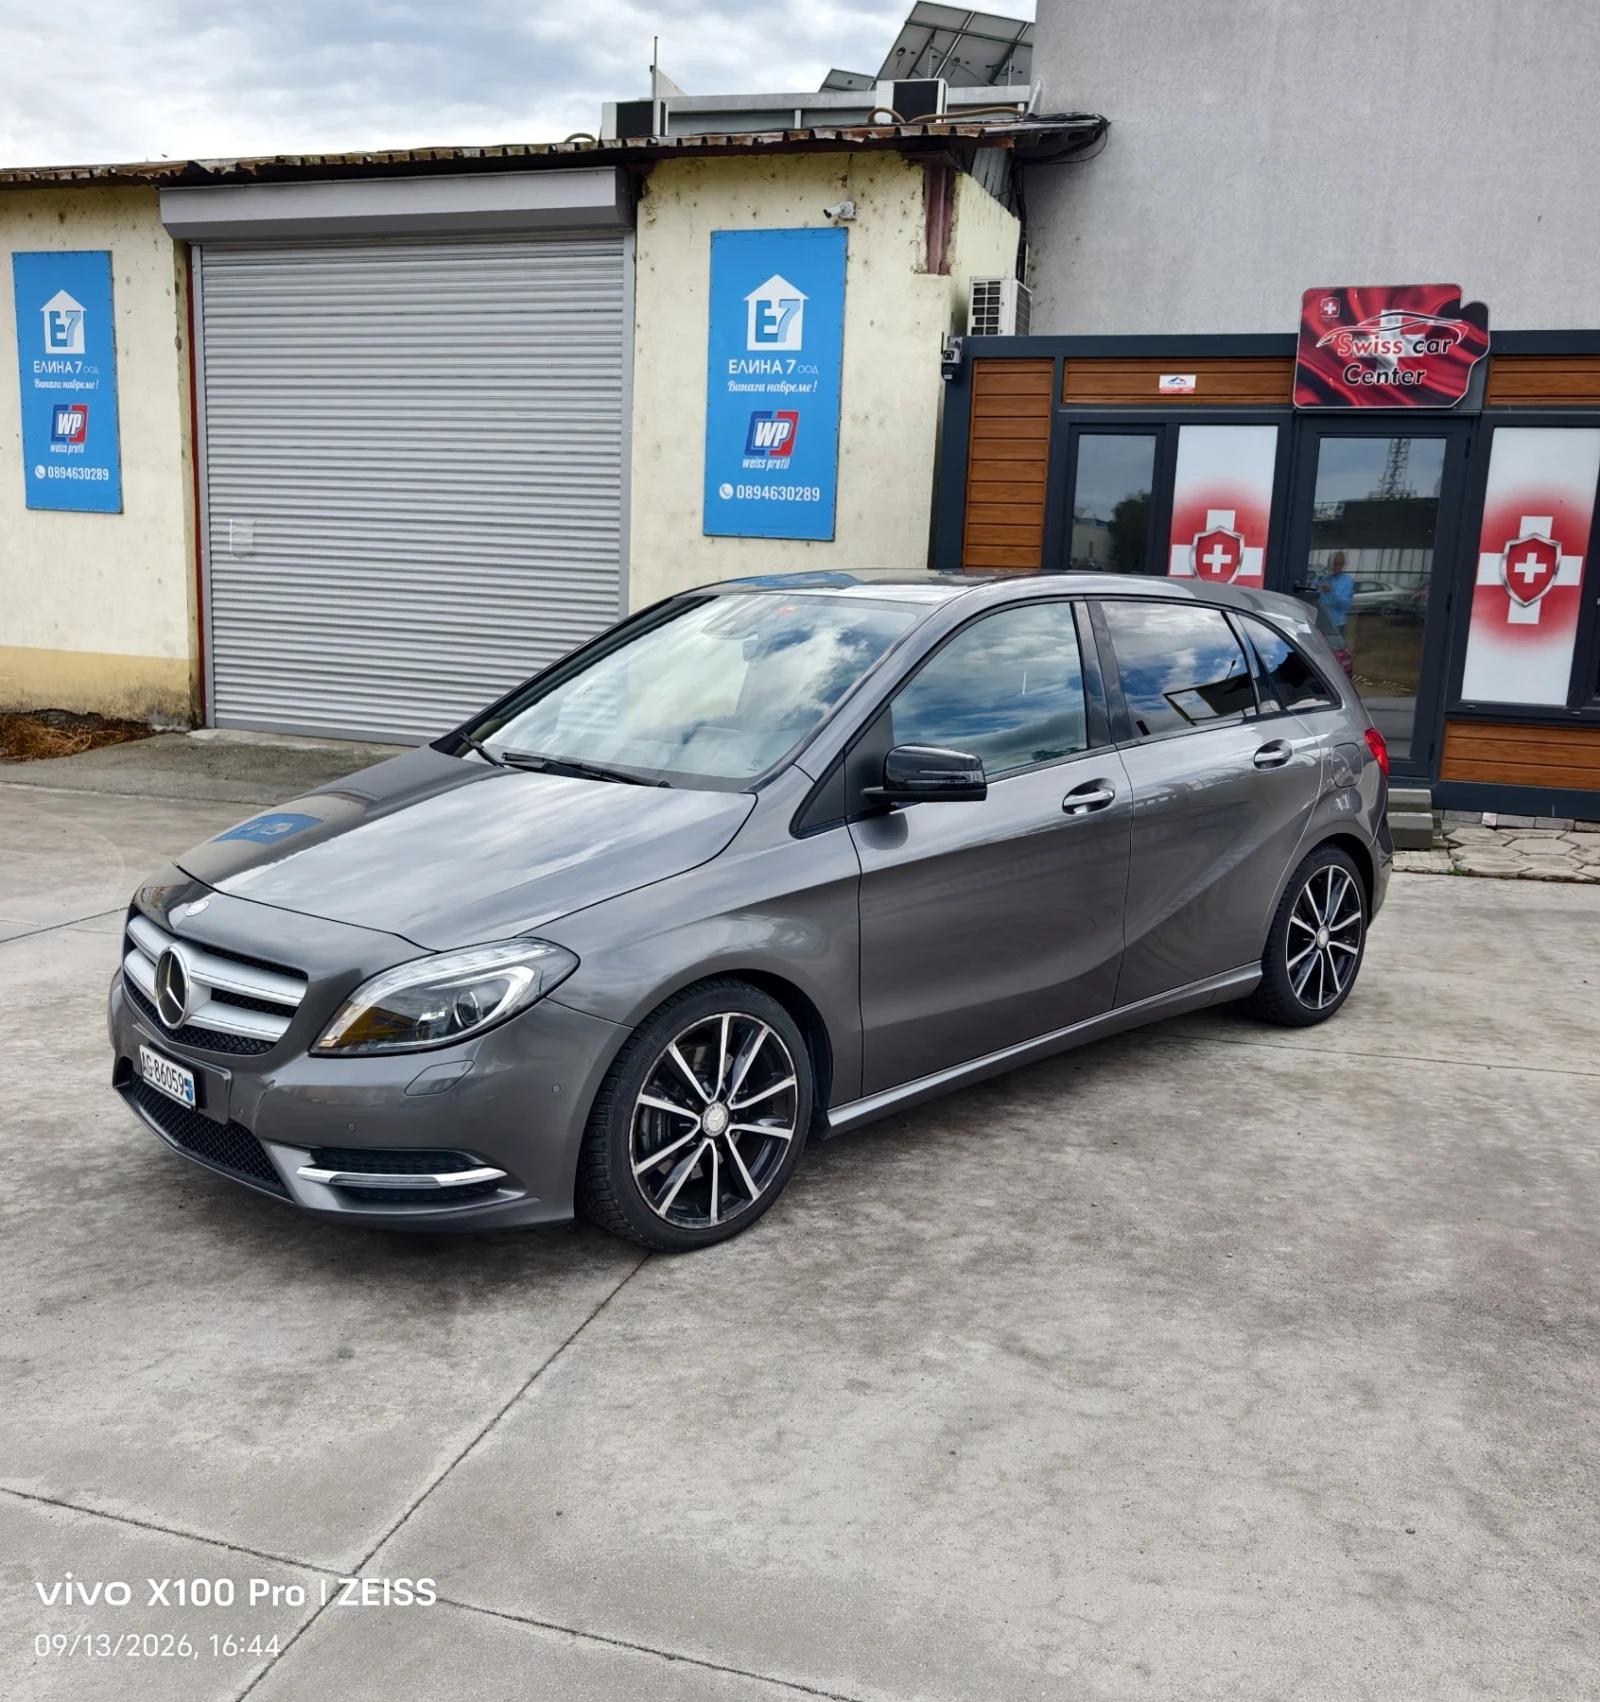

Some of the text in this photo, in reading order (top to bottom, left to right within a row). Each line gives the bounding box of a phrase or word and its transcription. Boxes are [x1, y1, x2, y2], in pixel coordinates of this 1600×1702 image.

[1337, 333, 1453, 357] Swiss car
[33, 360, 74, 374] ЕЛИНА
[74, 361, 82, 374] 7
[728, 359, 783, 375] ЕЛИНА
[786, 359, 797, 375] 7
[1343, 363, 1427, 386] Center
[728, 380, 766, 392] Винаги
[57, 413, 82, 435] WP
[754, 421, 790, 447] WP
[742, 457, 791, 472] weiss profil
[47, 466, 109, 481] 0894630289
[736, 484, 820, 502] 0894630289
